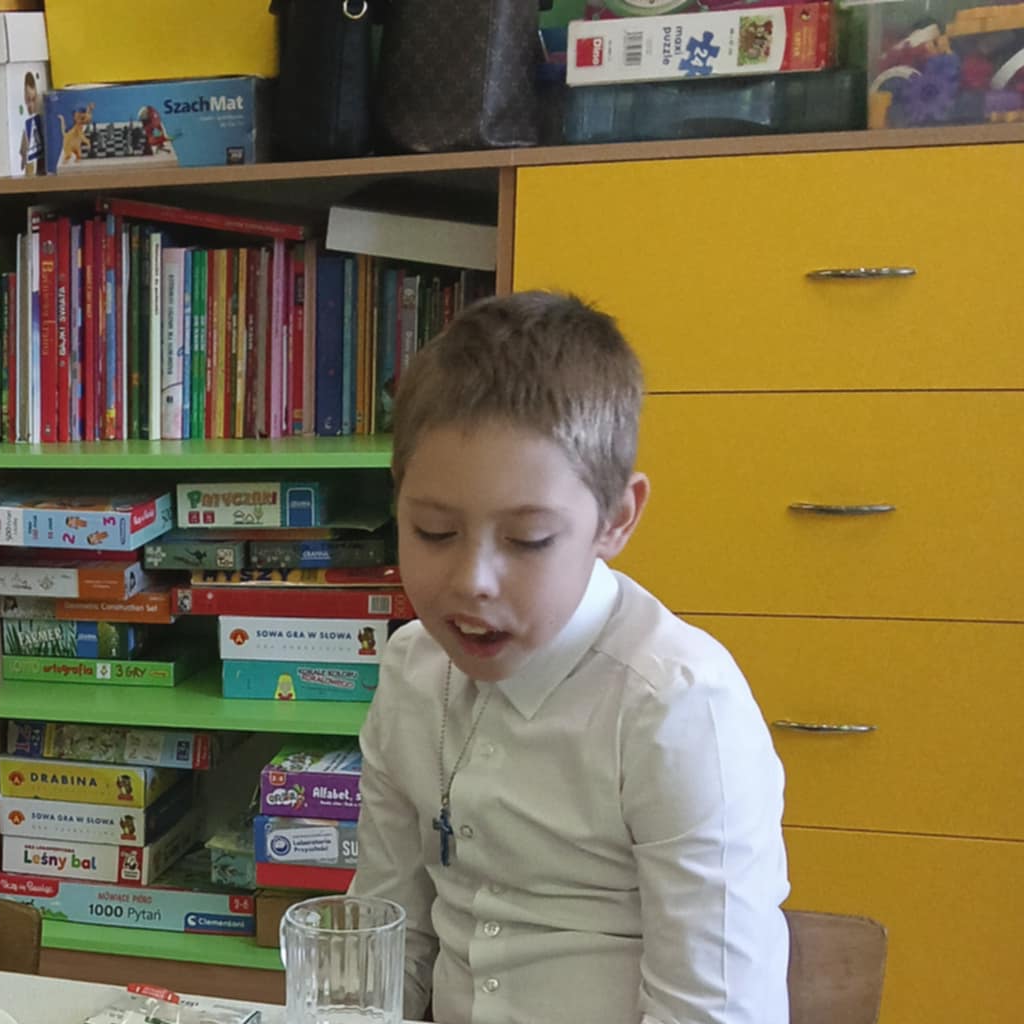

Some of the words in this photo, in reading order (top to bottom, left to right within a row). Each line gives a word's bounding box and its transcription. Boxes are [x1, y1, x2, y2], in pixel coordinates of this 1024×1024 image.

[662, 26, 673, 65] puzzle
[675, 25, 684, 55] maxi
[692, 47, 709, 67] 24
[163, 95, 244, 115] SzachMat
[62, 532, 75, 545] 2
[146, 603, 158, 613] Set
[256, 630, 283, 639] SOWA
[286, 630, 305, 639] GRA
[307, 631, 317, 639] W
[43, 663, 94, 676] ortografia
[115, 664, 123, 678] 3
[126, 666, 146, 679] GRY
[30, 772, 98, 788] DRABINA
[32, 812, 55, 822] SOWA
[57, 814, 75, 823] GRA
[342, 840, 359, 857] SU
[24, 850, 67, 870] Leśny
[71, 854, 97, 870] bal
[89, 904, 123, 918] 1000
[127, 907, 162, 922] Pytań
[198, 917, 245, 928] Clementoni
